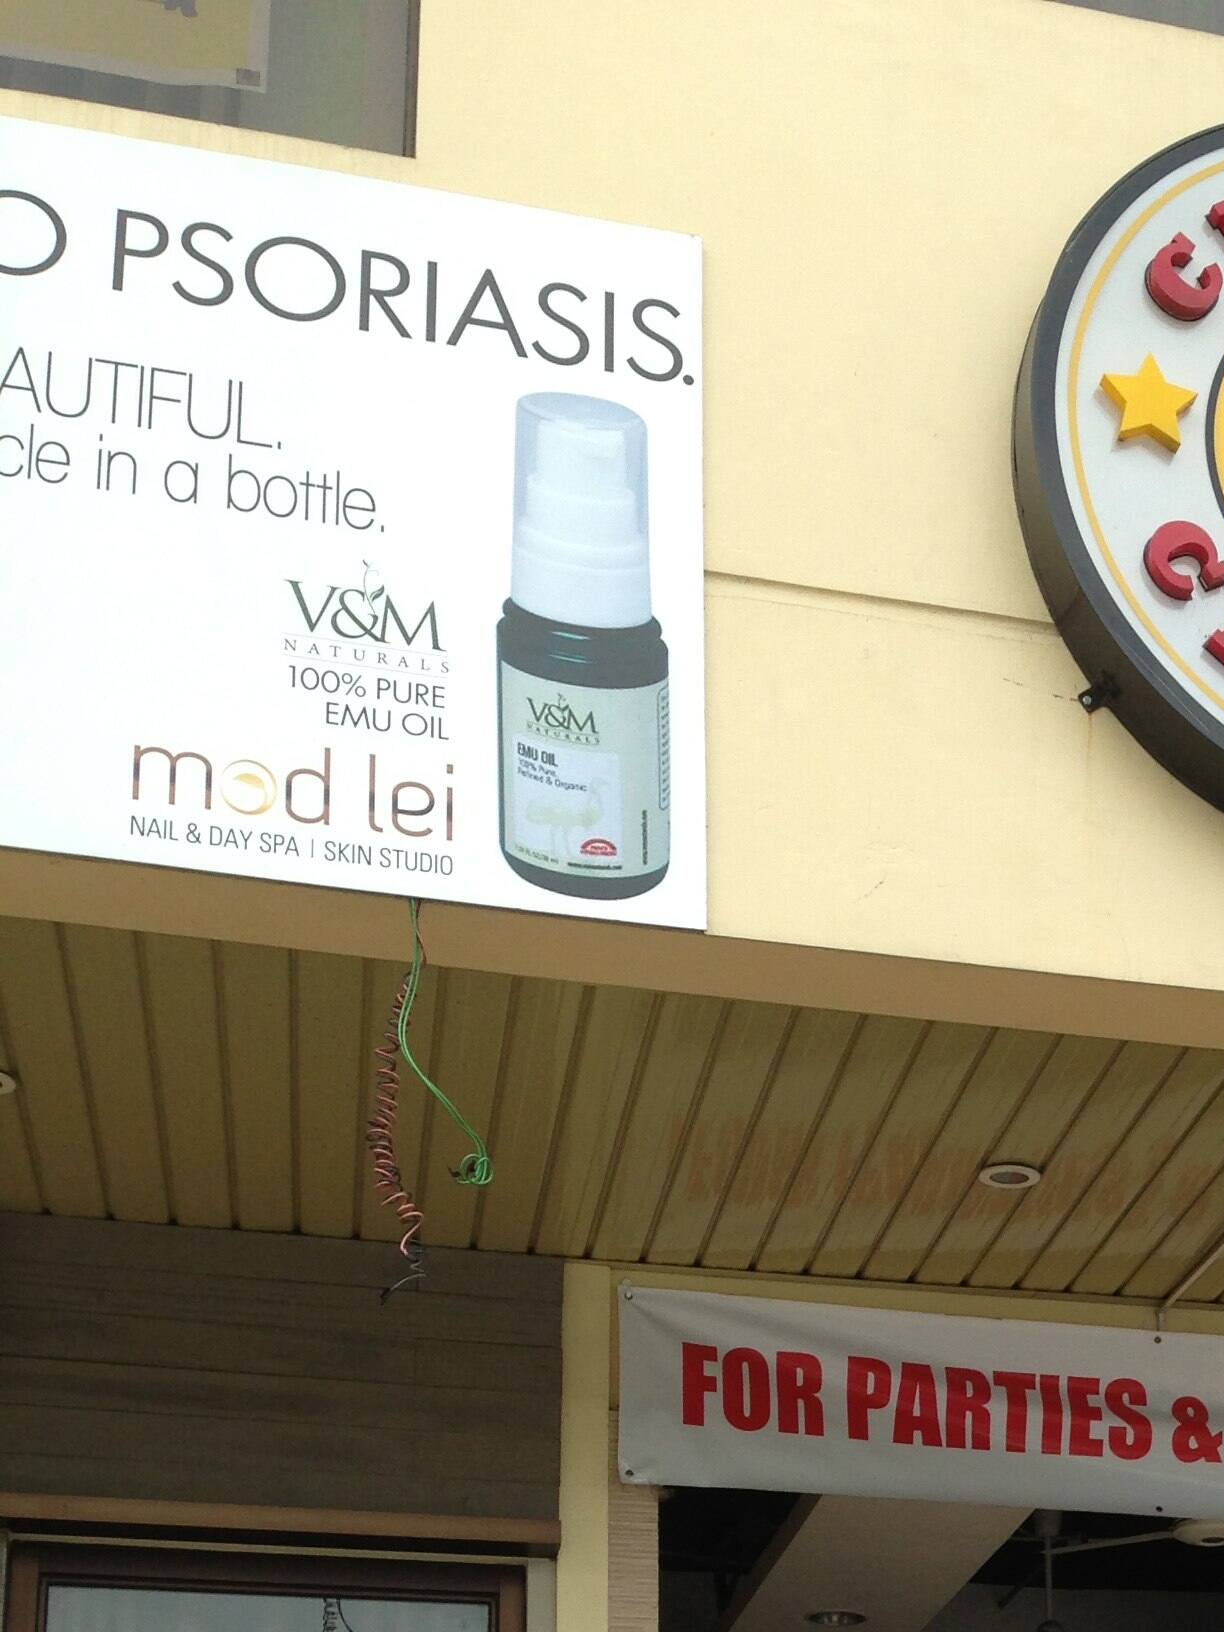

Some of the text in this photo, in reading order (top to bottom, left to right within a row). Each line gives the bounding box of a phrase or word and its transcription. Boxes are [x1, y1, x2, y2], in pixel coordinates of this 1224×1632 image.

[111, 208, 695, 386] PSORIASIS.
[97, 434, 138, 496] in
[164, 458, 199, 504] a
[227, 454, 386, 533] bottle.
[283, 578, 447, 652] V&M
[283, 638, 449, 674] NATURALS
[289, 665, 446, 709] 100% PURE
[526, 696, 599, 734] V&M
[326, 702, 449, 740] EMU OIL
[517, 742, 558, 768] EMU OIL
[369, 754, 453, 841] lei
[130, 815, 454, 876] NAIL & DAY SPA SKIN STUDIO
[681, 1341, 824, 1437] FOR
[847, 1355, 1148, 1461] PARTIES
[1171, 1395, 1223, 1464] &
